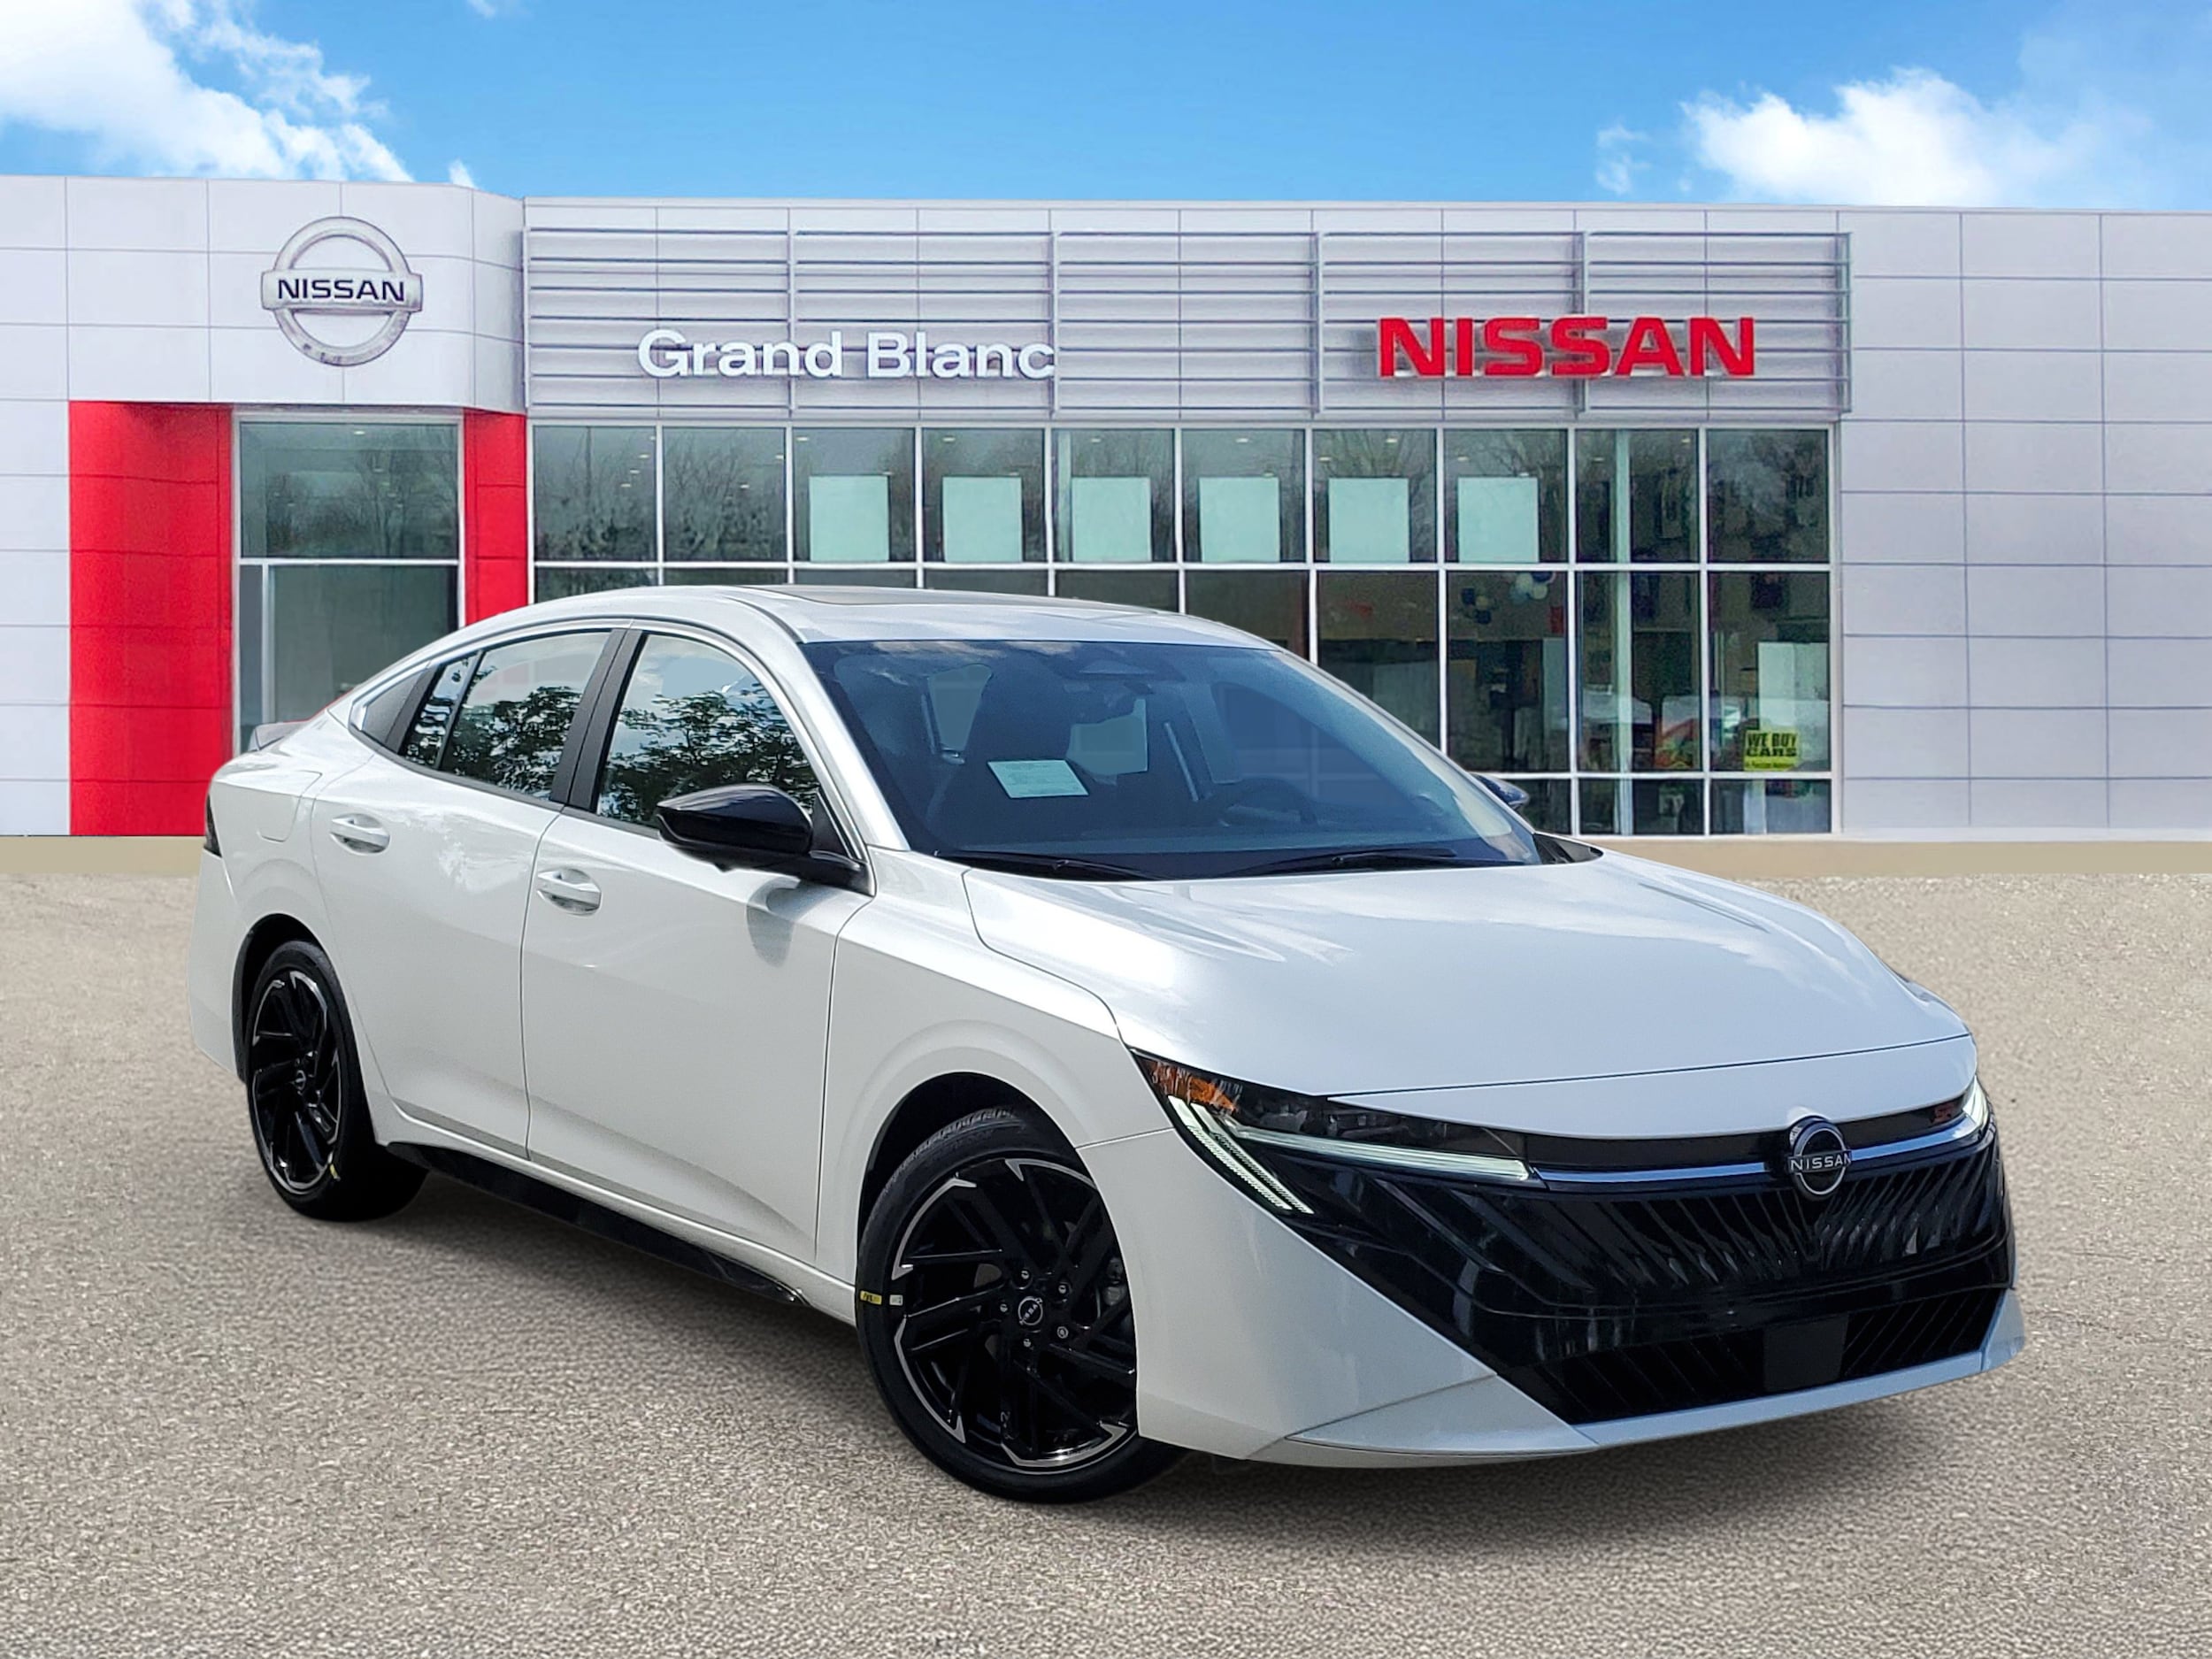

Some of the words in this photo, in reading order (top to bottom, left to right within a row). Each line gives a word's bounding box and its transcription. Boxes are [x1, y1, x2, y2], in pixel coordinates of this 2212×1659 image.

[278, 279, 404, 302] NISSAN
[638, 328, 842, 379] Grand
[867, 331, 1056, 380] Blanc
[1379, 317, 1755, 377] NISSAN
[1747, 733, 1768, 747] WE
[1772, 733, 1797, 747] BUY
[1747, 748, 1797, 757] CARS
[1790, 1152, 1852, 1171] NISSAN
